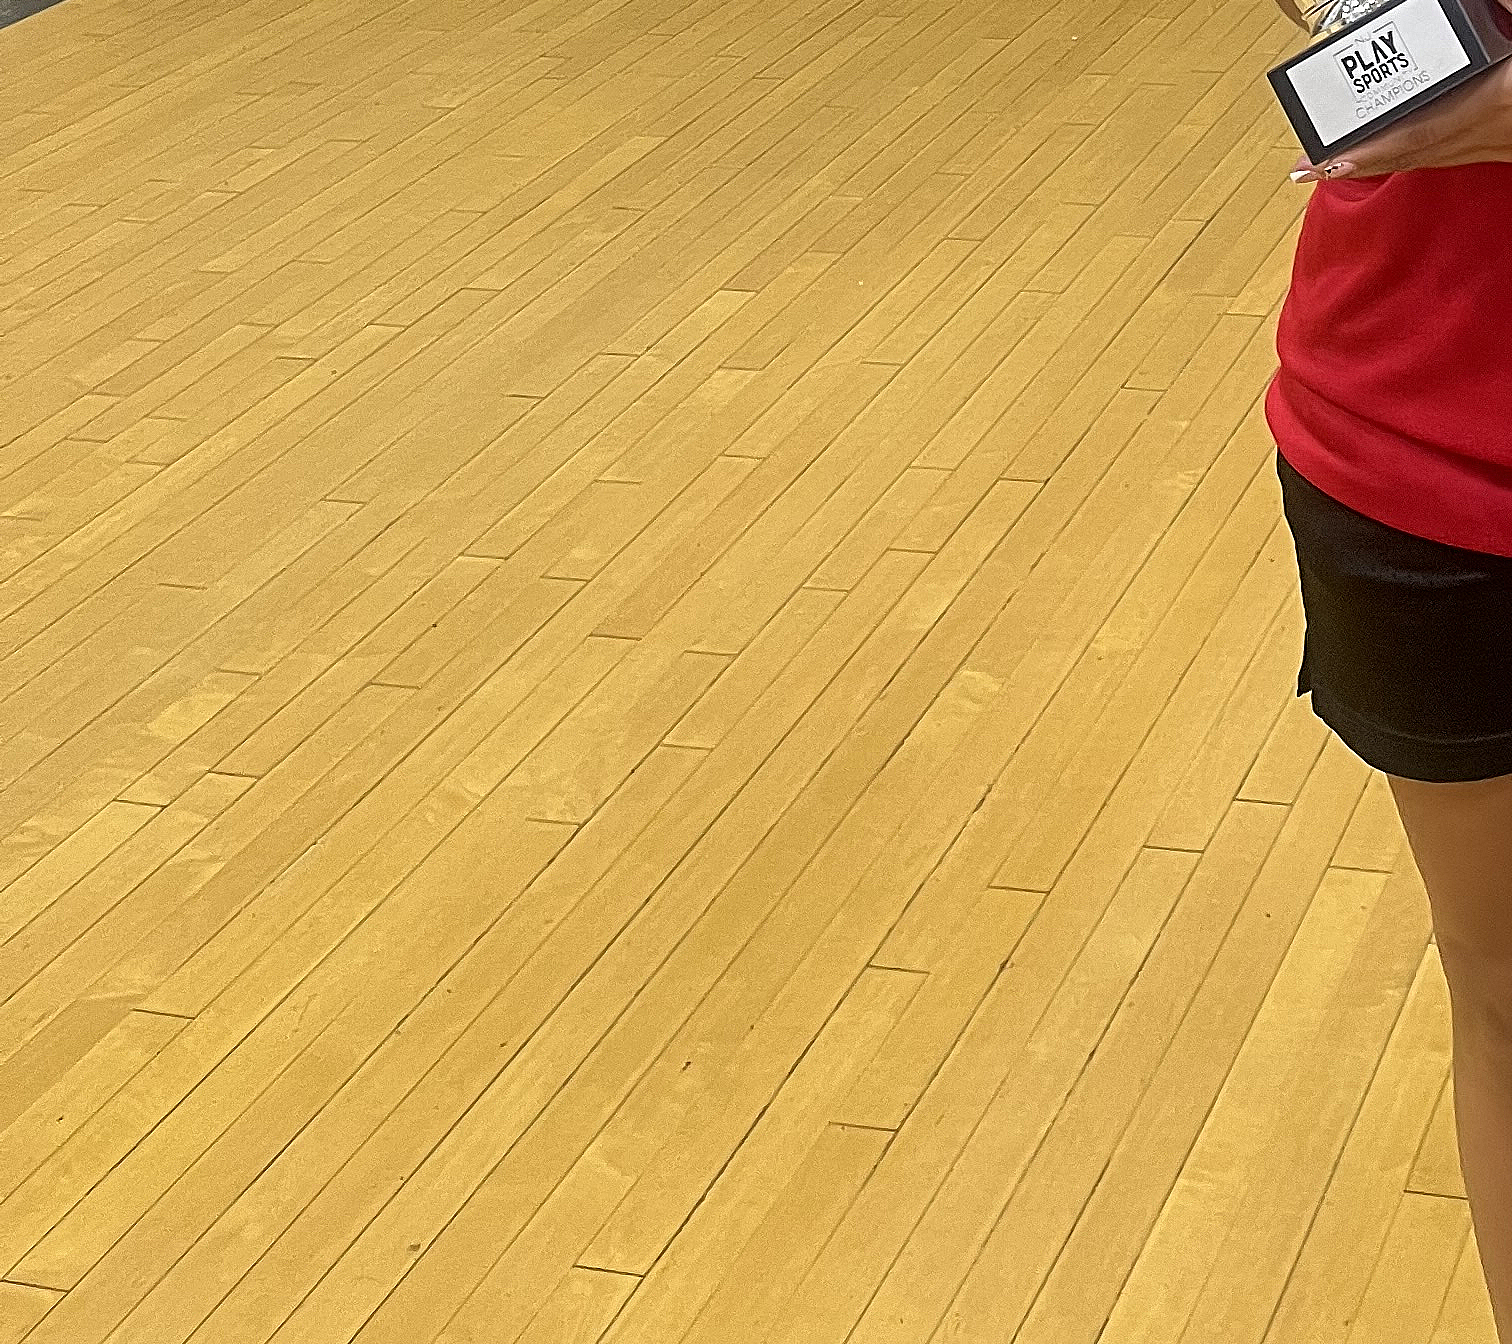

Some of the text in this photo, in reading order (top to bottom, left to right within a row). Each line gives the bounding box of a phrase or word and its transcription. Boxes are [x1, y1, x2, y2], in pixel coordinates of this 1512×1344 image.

[1340, 30, 1398, 80] PLAY
[1353, 52, 1409, 94] SPORTS
[1355, 70, 1431, 119] CHAMPIONS
